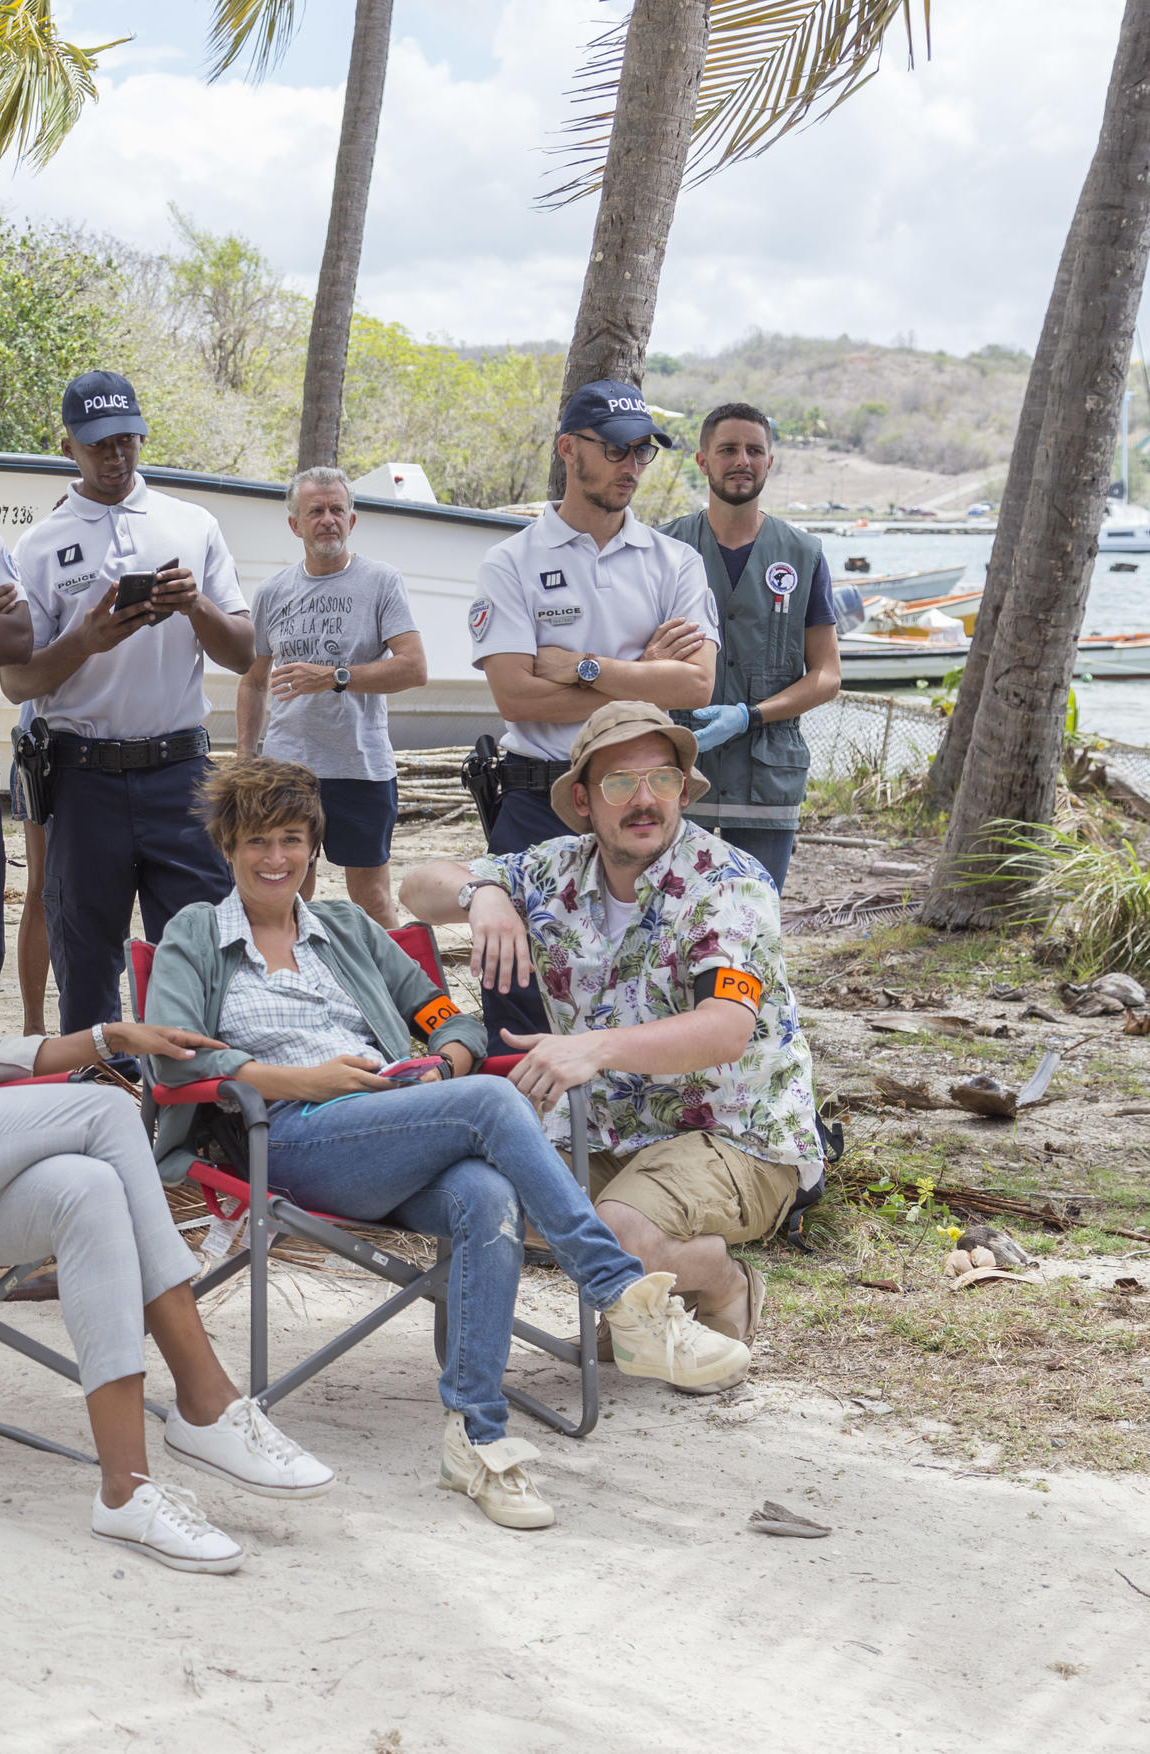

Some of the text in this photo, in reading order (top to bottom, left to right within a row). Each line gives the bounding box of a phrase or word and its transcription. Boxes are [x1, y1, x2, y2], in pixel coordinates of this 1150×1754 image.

[84, 394, 129, 414] POLICE
[57, 572, 97, 590] POLICE
[300, 596, 353, 614] LAISSONS
[538, 607, 581, 618] POLICE
[302, 618, 316, 634] LA
[321, 616, 343, 634] MER
[722, 977, 756, 1002] POL
